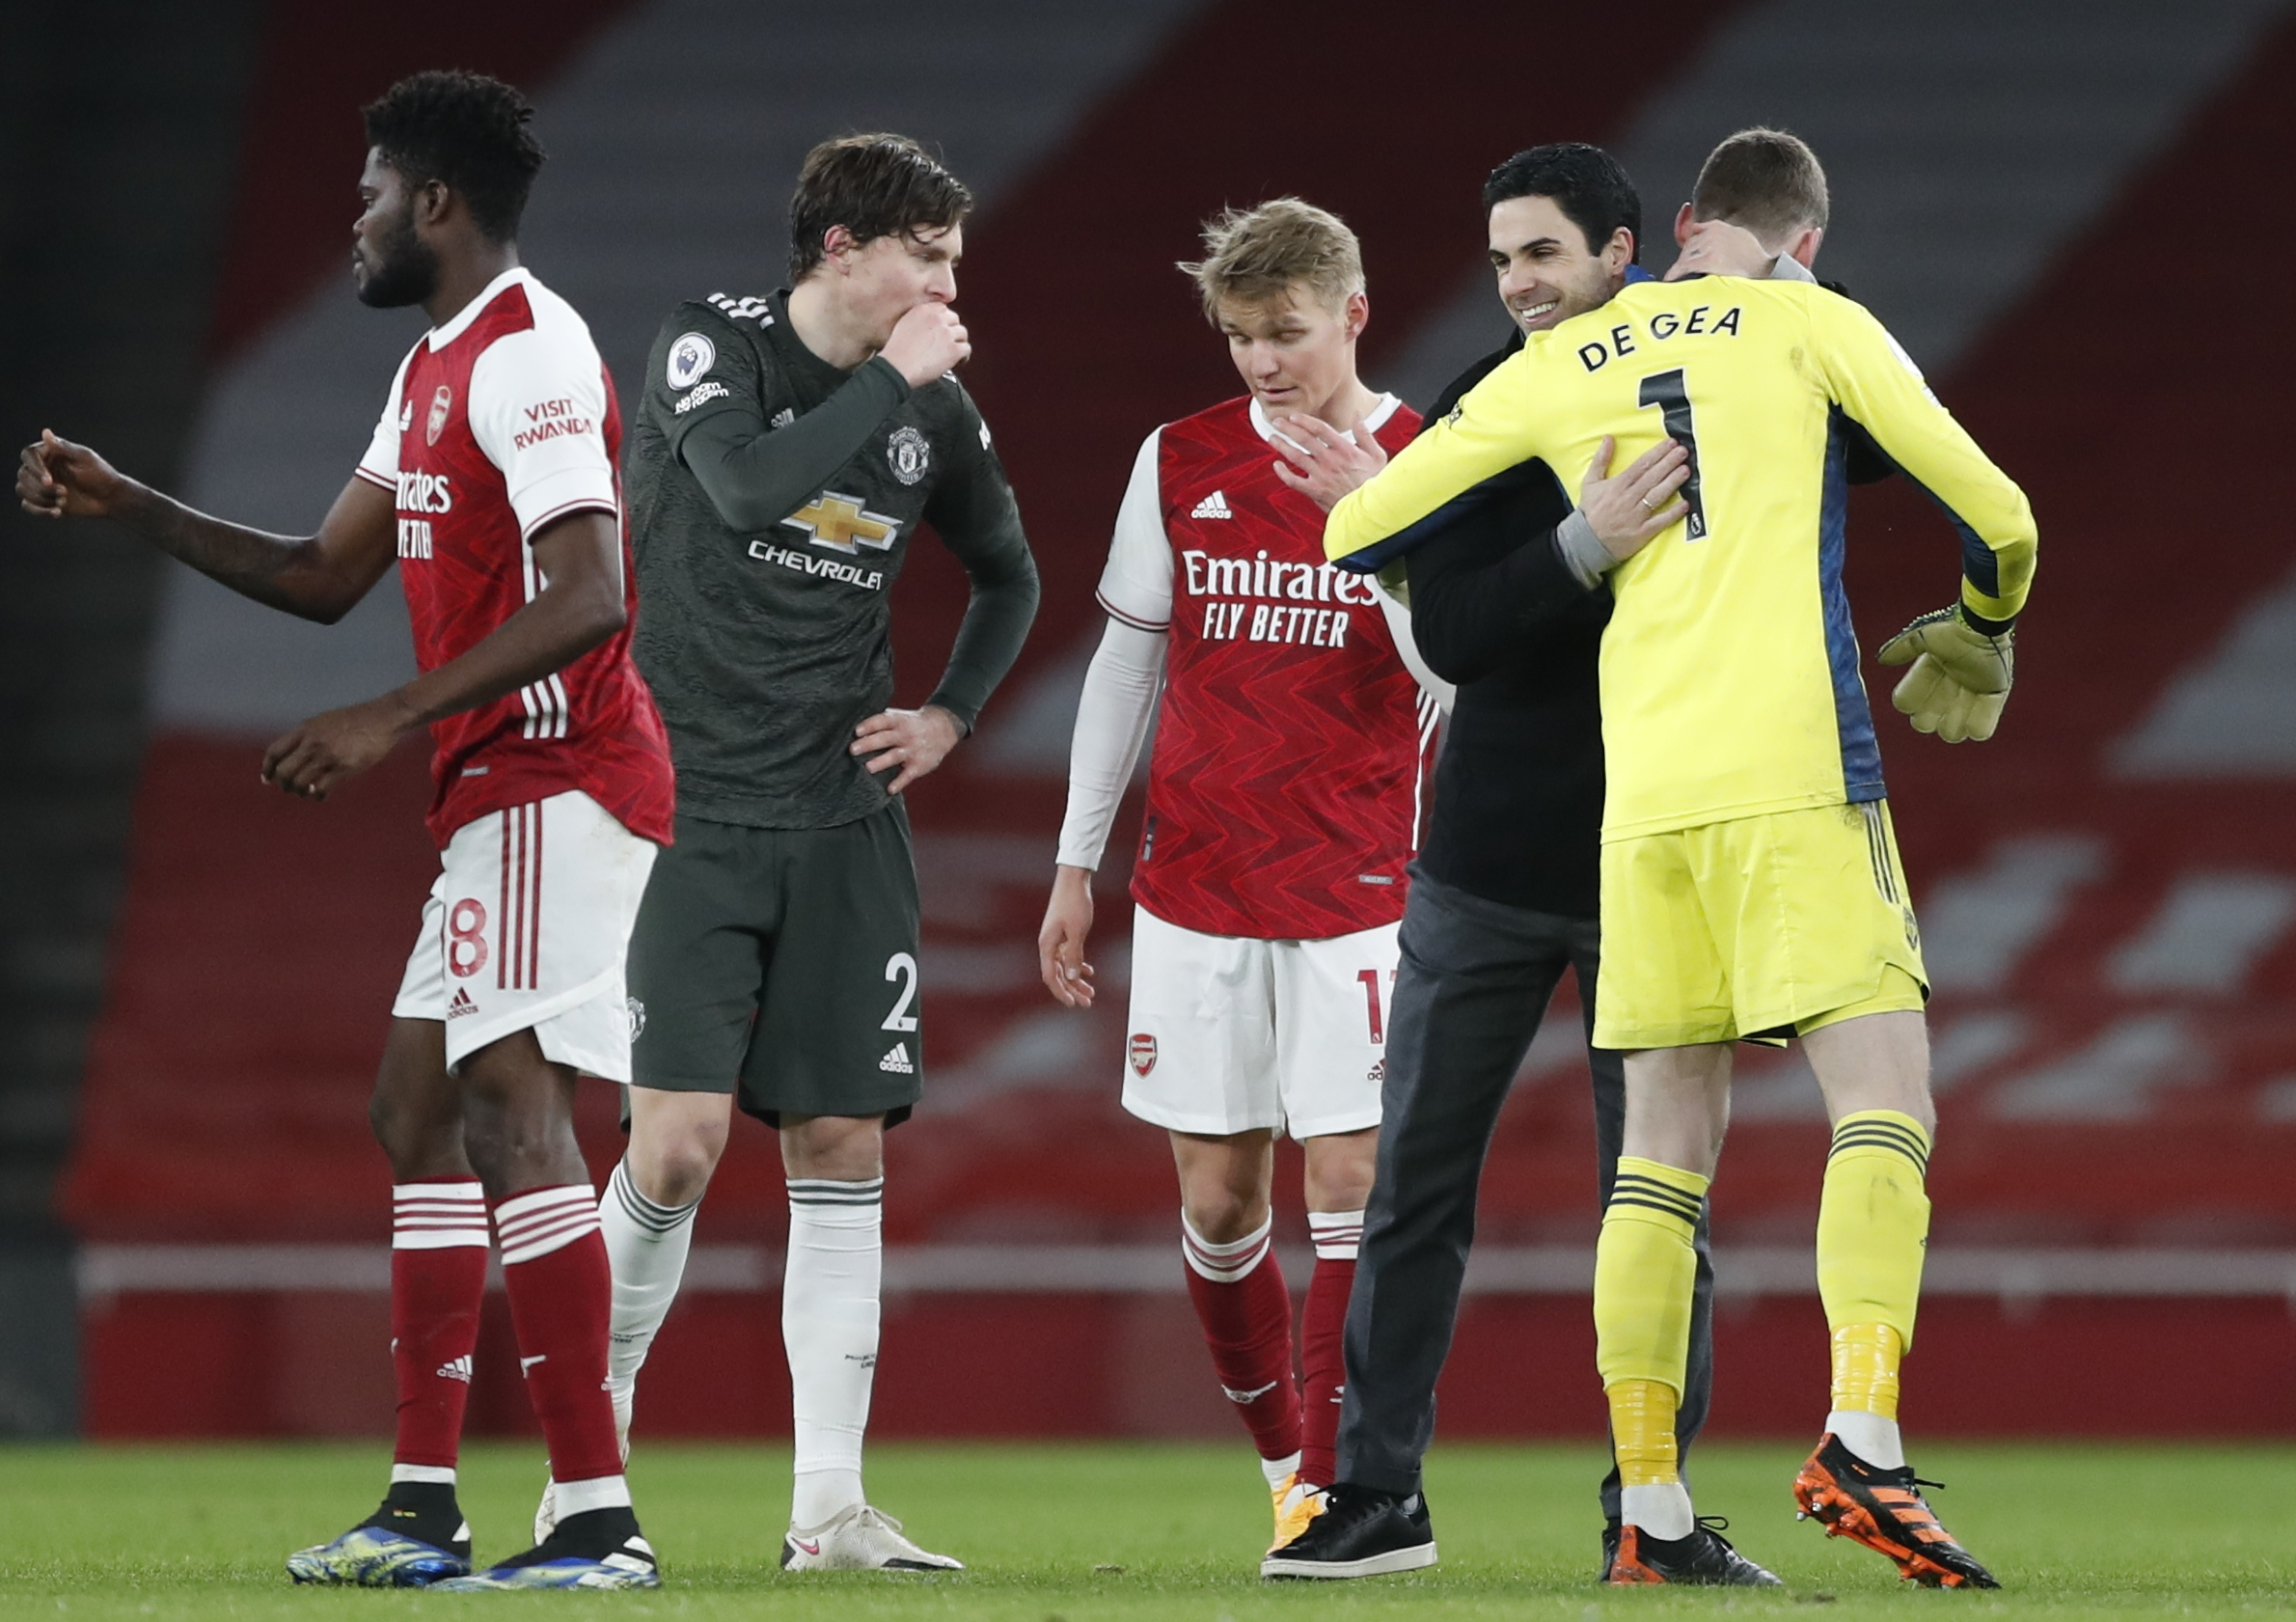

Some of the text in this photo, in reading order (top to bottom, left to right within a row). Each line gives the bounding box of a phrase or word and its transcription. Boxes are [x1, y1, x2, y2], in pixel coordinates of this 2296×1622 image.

[1578, 306, 1740, 372] DE GEA
[524, 399, 573, 422] VISIT
[690, 382, 721, 400] room
[513, 419, 593, 451] RWANDA
[1637, 368, 1707, 541] 1
[1190, 509, 1232, 519] adidas
[749, 540, 884, 591] CHEVROLET
[1182, 549, 1380, 606] Emirates
[1202, 603, 1349, 647] FLY BETTER
[450, 898, 488, 978] 8
[881, 951, 917, 1031] 2
[1356, 969, 1398, 1044] 1
[879, 1060, 914, 1074] adidas
